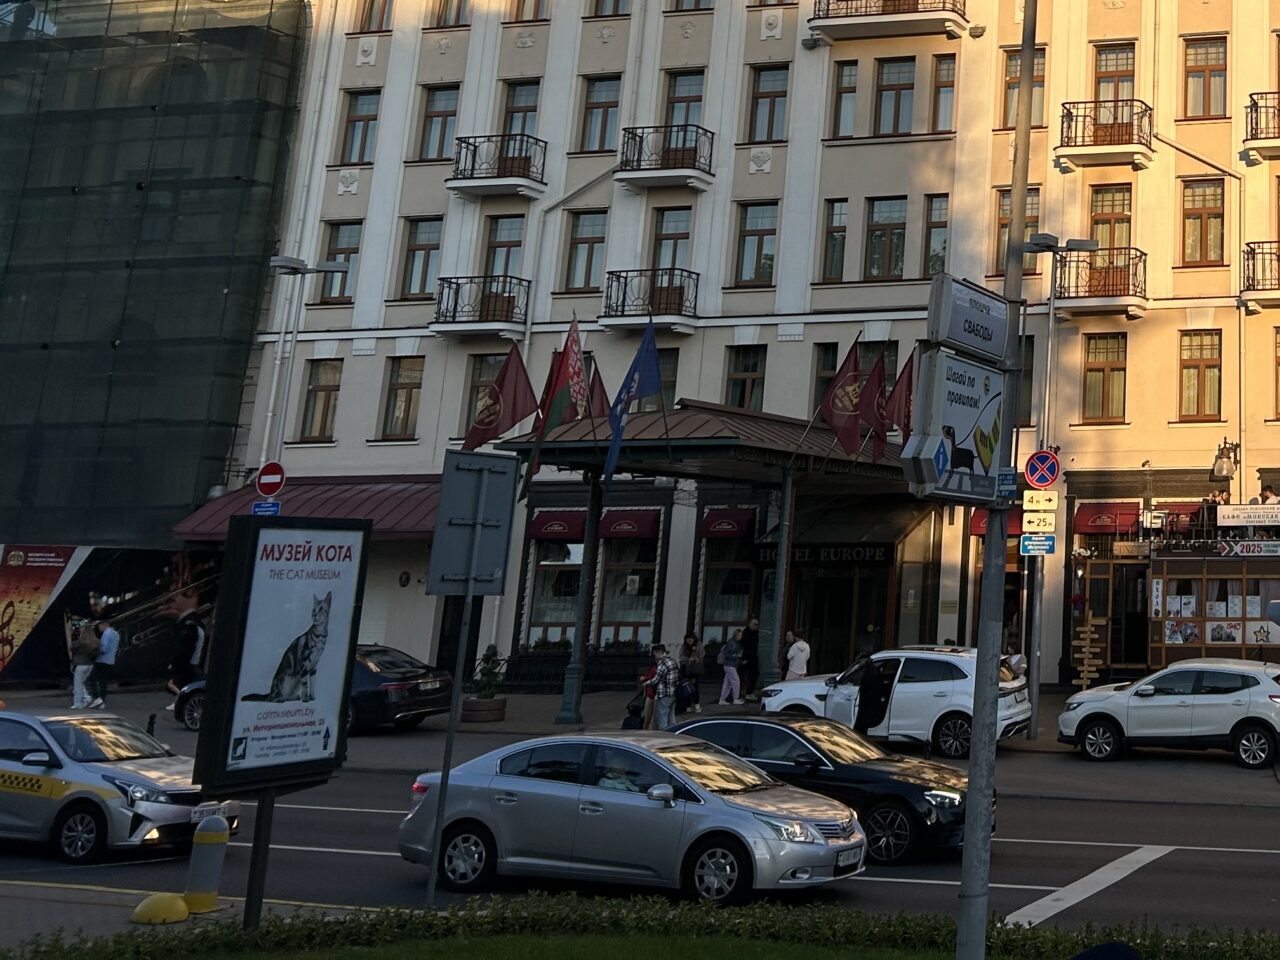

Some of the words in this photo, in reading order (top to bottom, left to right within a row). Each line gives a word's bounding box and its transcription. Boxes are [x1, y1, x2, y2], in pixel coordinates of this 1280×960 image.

[1027, 496, 1035, 505] 4
[1036, 518, 1048, 528] 25
[260, 540, 312, 562] МУЗЕЙ
[315, 544, 353, 562] КОТА
[759, 548, 814, 561] HOEL
[820, 547, 886, 561] EUROPE
[1239, 543, 1263, 554] 2025
[269, 569, 285, 581] THE
[286, 569, 304, 581] CAT
[305, 569, 341, 581] MUSEUM
[256, 707, 316, 721] catmuseum.by
